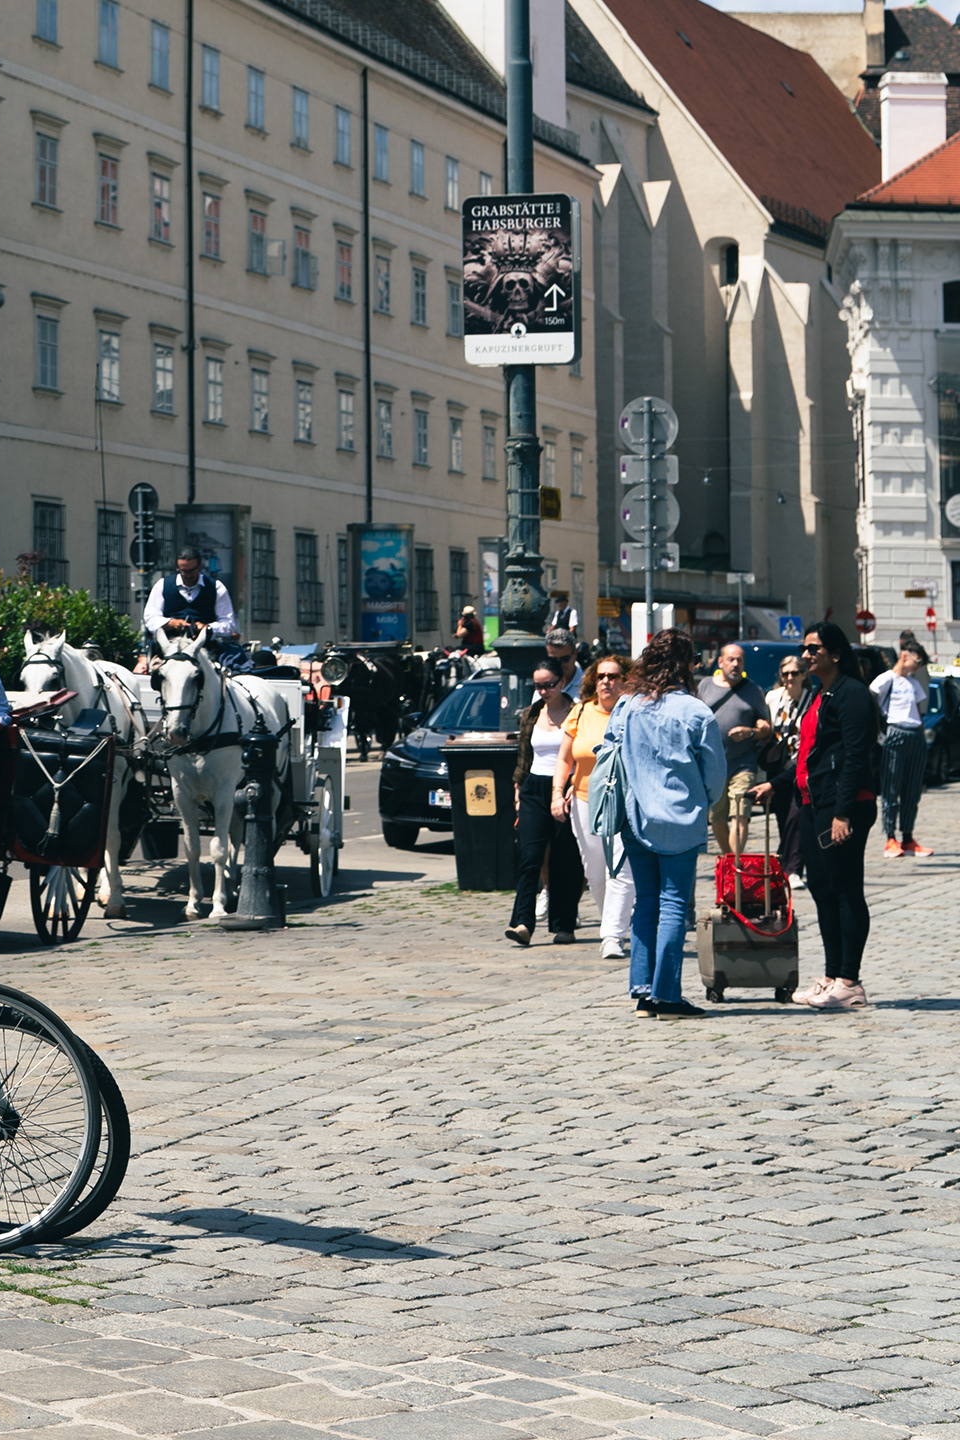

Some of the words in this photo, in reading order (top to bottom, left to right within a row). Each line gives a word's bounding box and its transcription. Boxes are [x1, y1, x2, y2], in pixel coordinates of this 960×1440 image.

[471, 201, 555, 218] GRABSTÄTTE
[471, 217, 562, 232] HABSBURGER
[544, 317, 565, 326] 150m
[475, 343, 563, 354] KAPUZINERGRUFT
